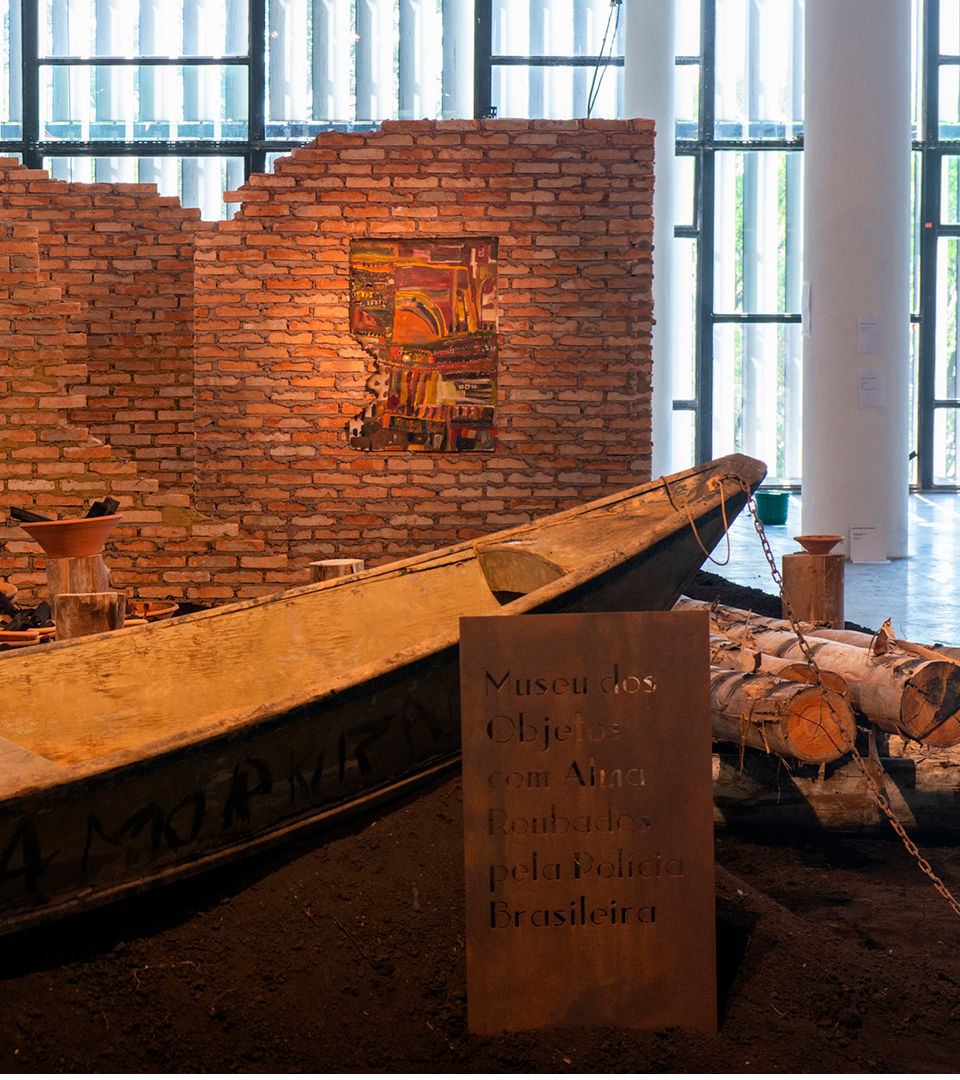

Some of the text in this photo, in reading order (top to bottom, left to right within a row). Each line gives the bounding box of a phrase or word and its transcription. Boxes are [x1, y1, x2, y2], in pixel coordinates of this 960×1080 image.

[484, 663, 657, 697] Museu dos
[486, 711, 622, 752] Objetos
[487, 756, 646, 791] com Alma
[487, 801, 652, 837] Roubados
[489, 850, 561, 893] pela
[489, 895, 657, 930] Brasileira
